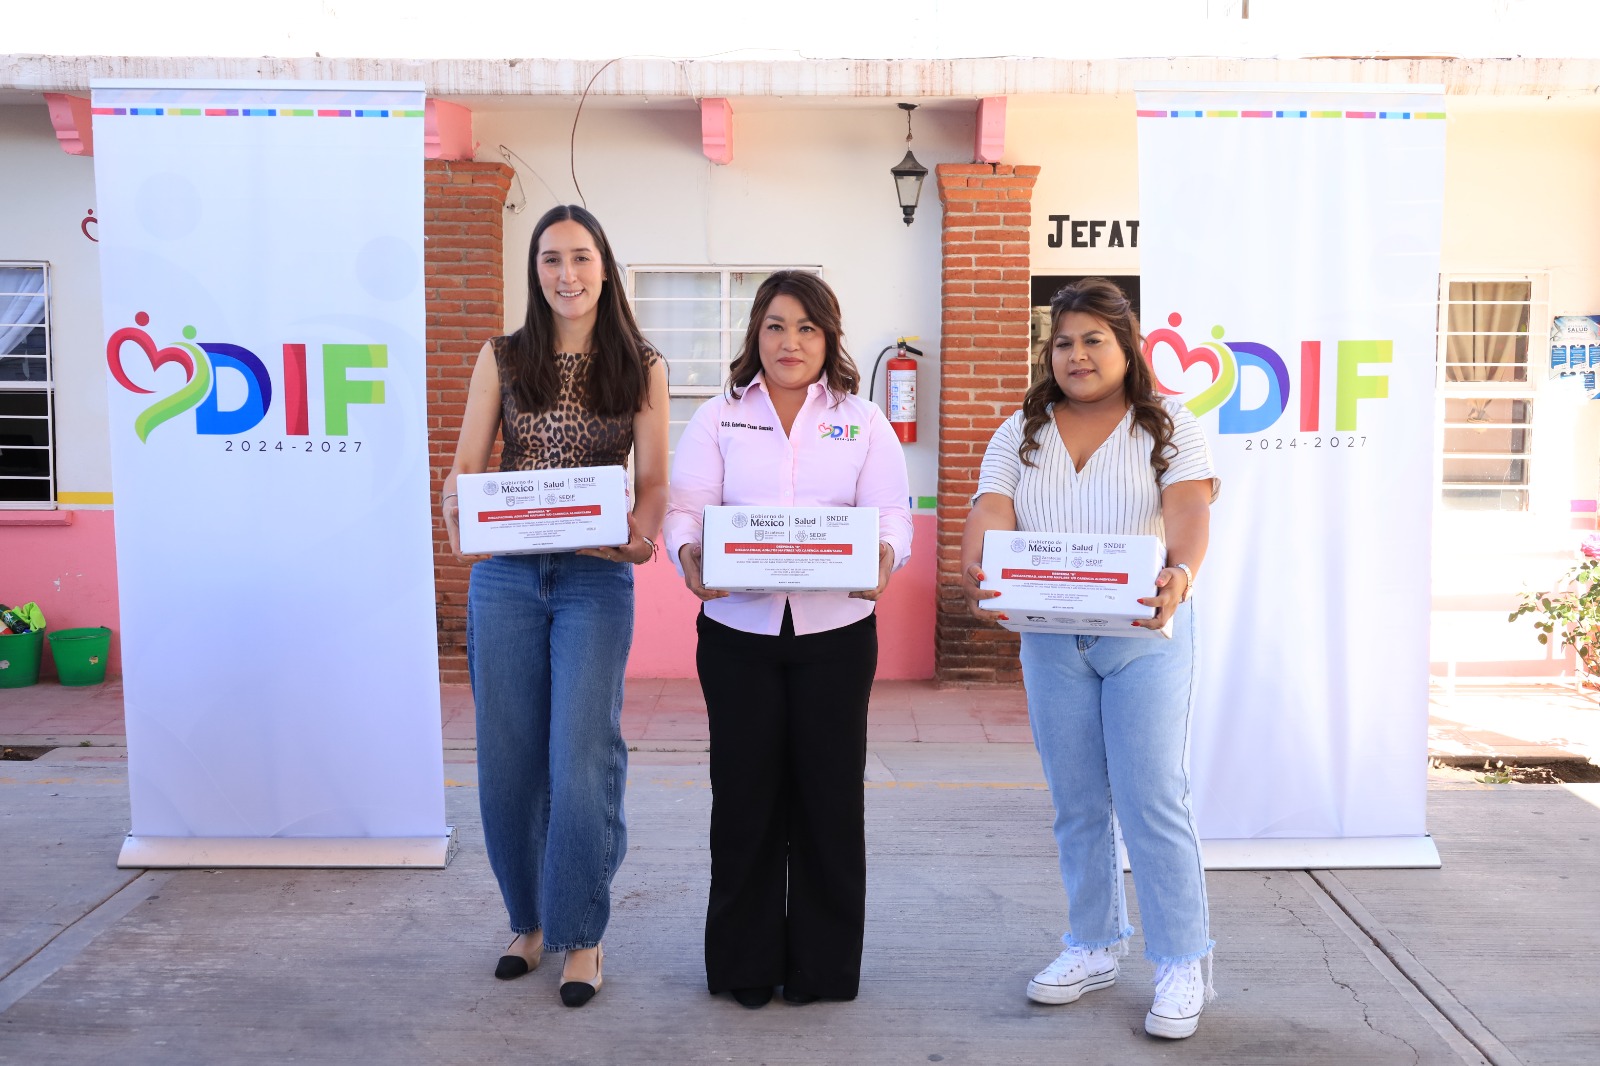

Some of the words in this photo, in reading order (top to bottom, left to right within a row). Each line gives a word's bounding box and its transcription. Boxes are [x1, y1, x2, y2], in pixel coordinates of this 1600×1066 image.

[195, 342, 388, 436] DIF
[1218, 340, 1393, 435] DIF
[831, 425, 860, 438] DIF
[225, 440, 362, 453] 2024-2027
[1245, 436, 1367, 450] 2024-2027
[501, 485, 534, 493] México
[543, 481, 564, 489] Salud
[750, 518, 785, 527] México
[794, 517, 816, 525] Salud
[1028, 544, 1062, 553] México
[1071, 543, 1093, 551] Salud
